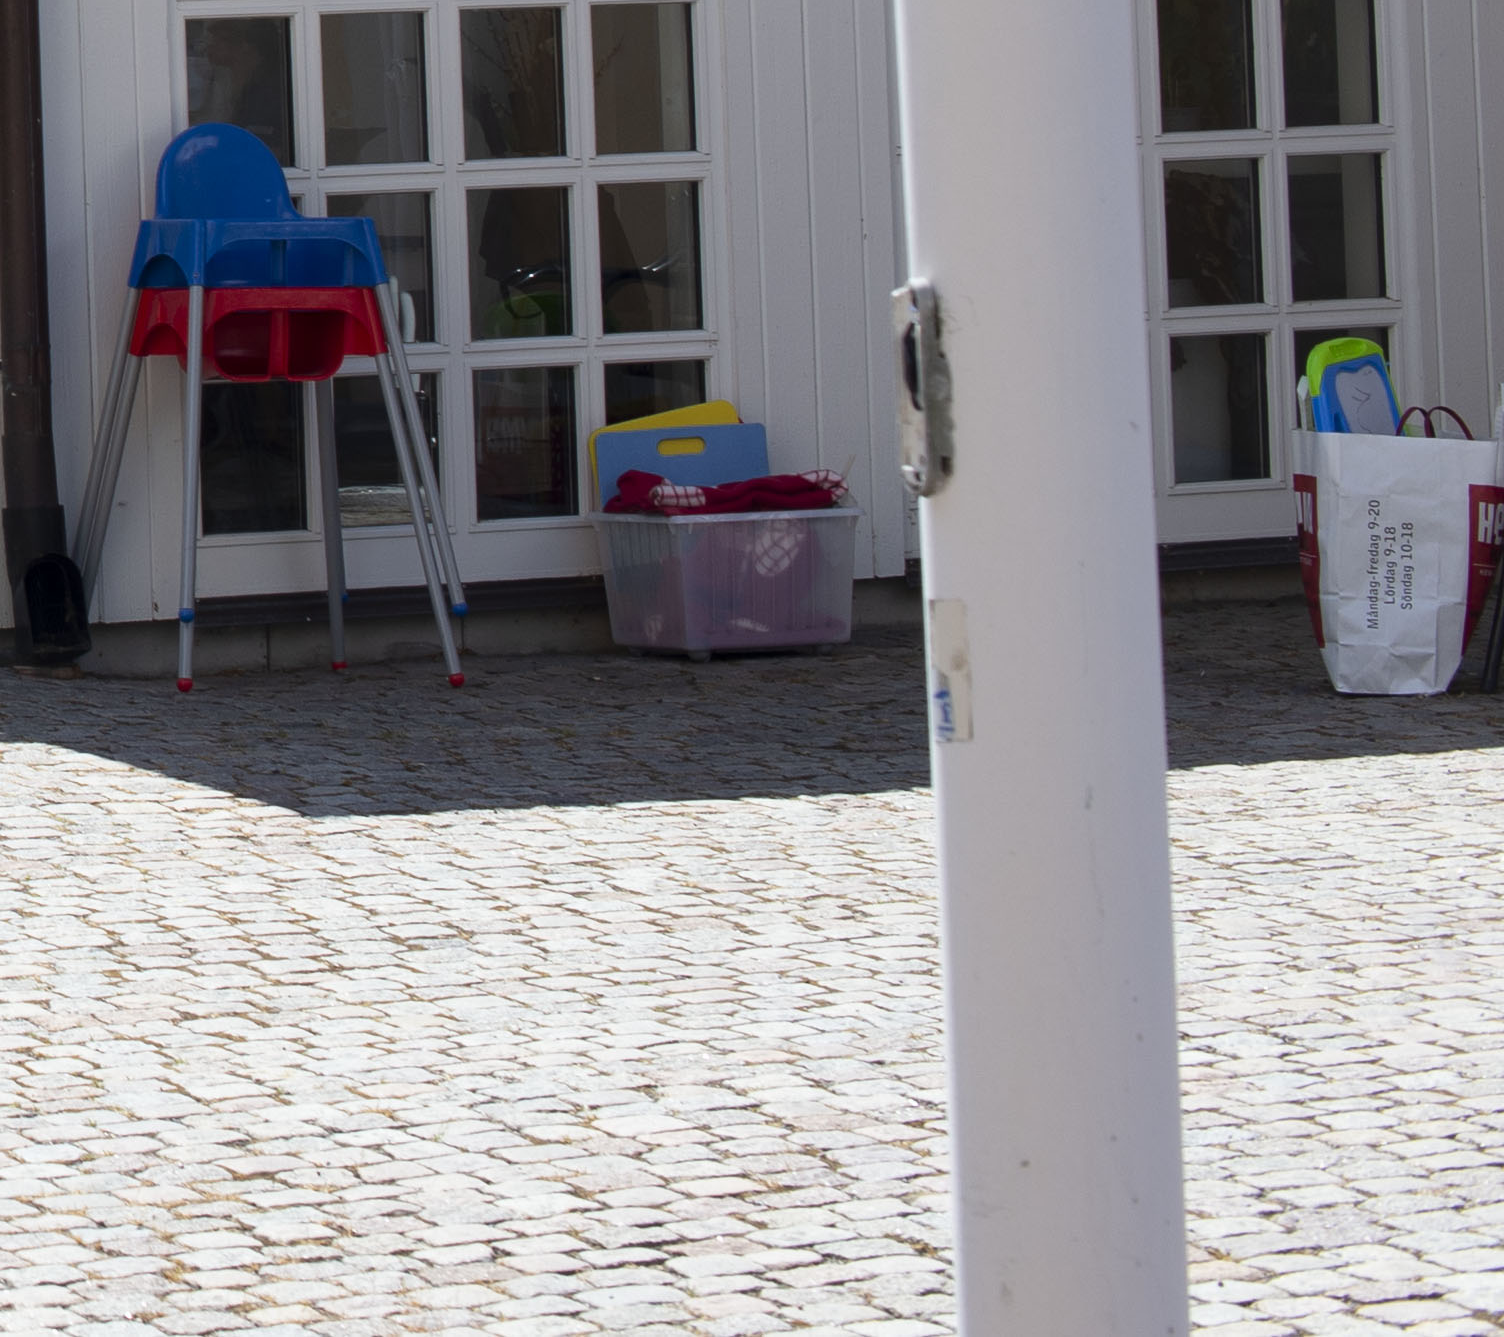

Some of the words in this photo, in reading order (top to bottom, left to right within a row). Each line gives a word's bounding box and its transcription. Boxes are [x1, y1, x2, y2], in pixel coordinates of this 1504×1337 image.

[1367, 499, 1381, 530] 9-20
[1383, 526, 1397, 557] 9-18
[1400, 521, 1414, 561] 10-18
[1366, 534, 1382, 630] Måndag-fredag
[1383, 561, 1398, 605] Lördag
[1400, 565, 1415, 610] Söndag
